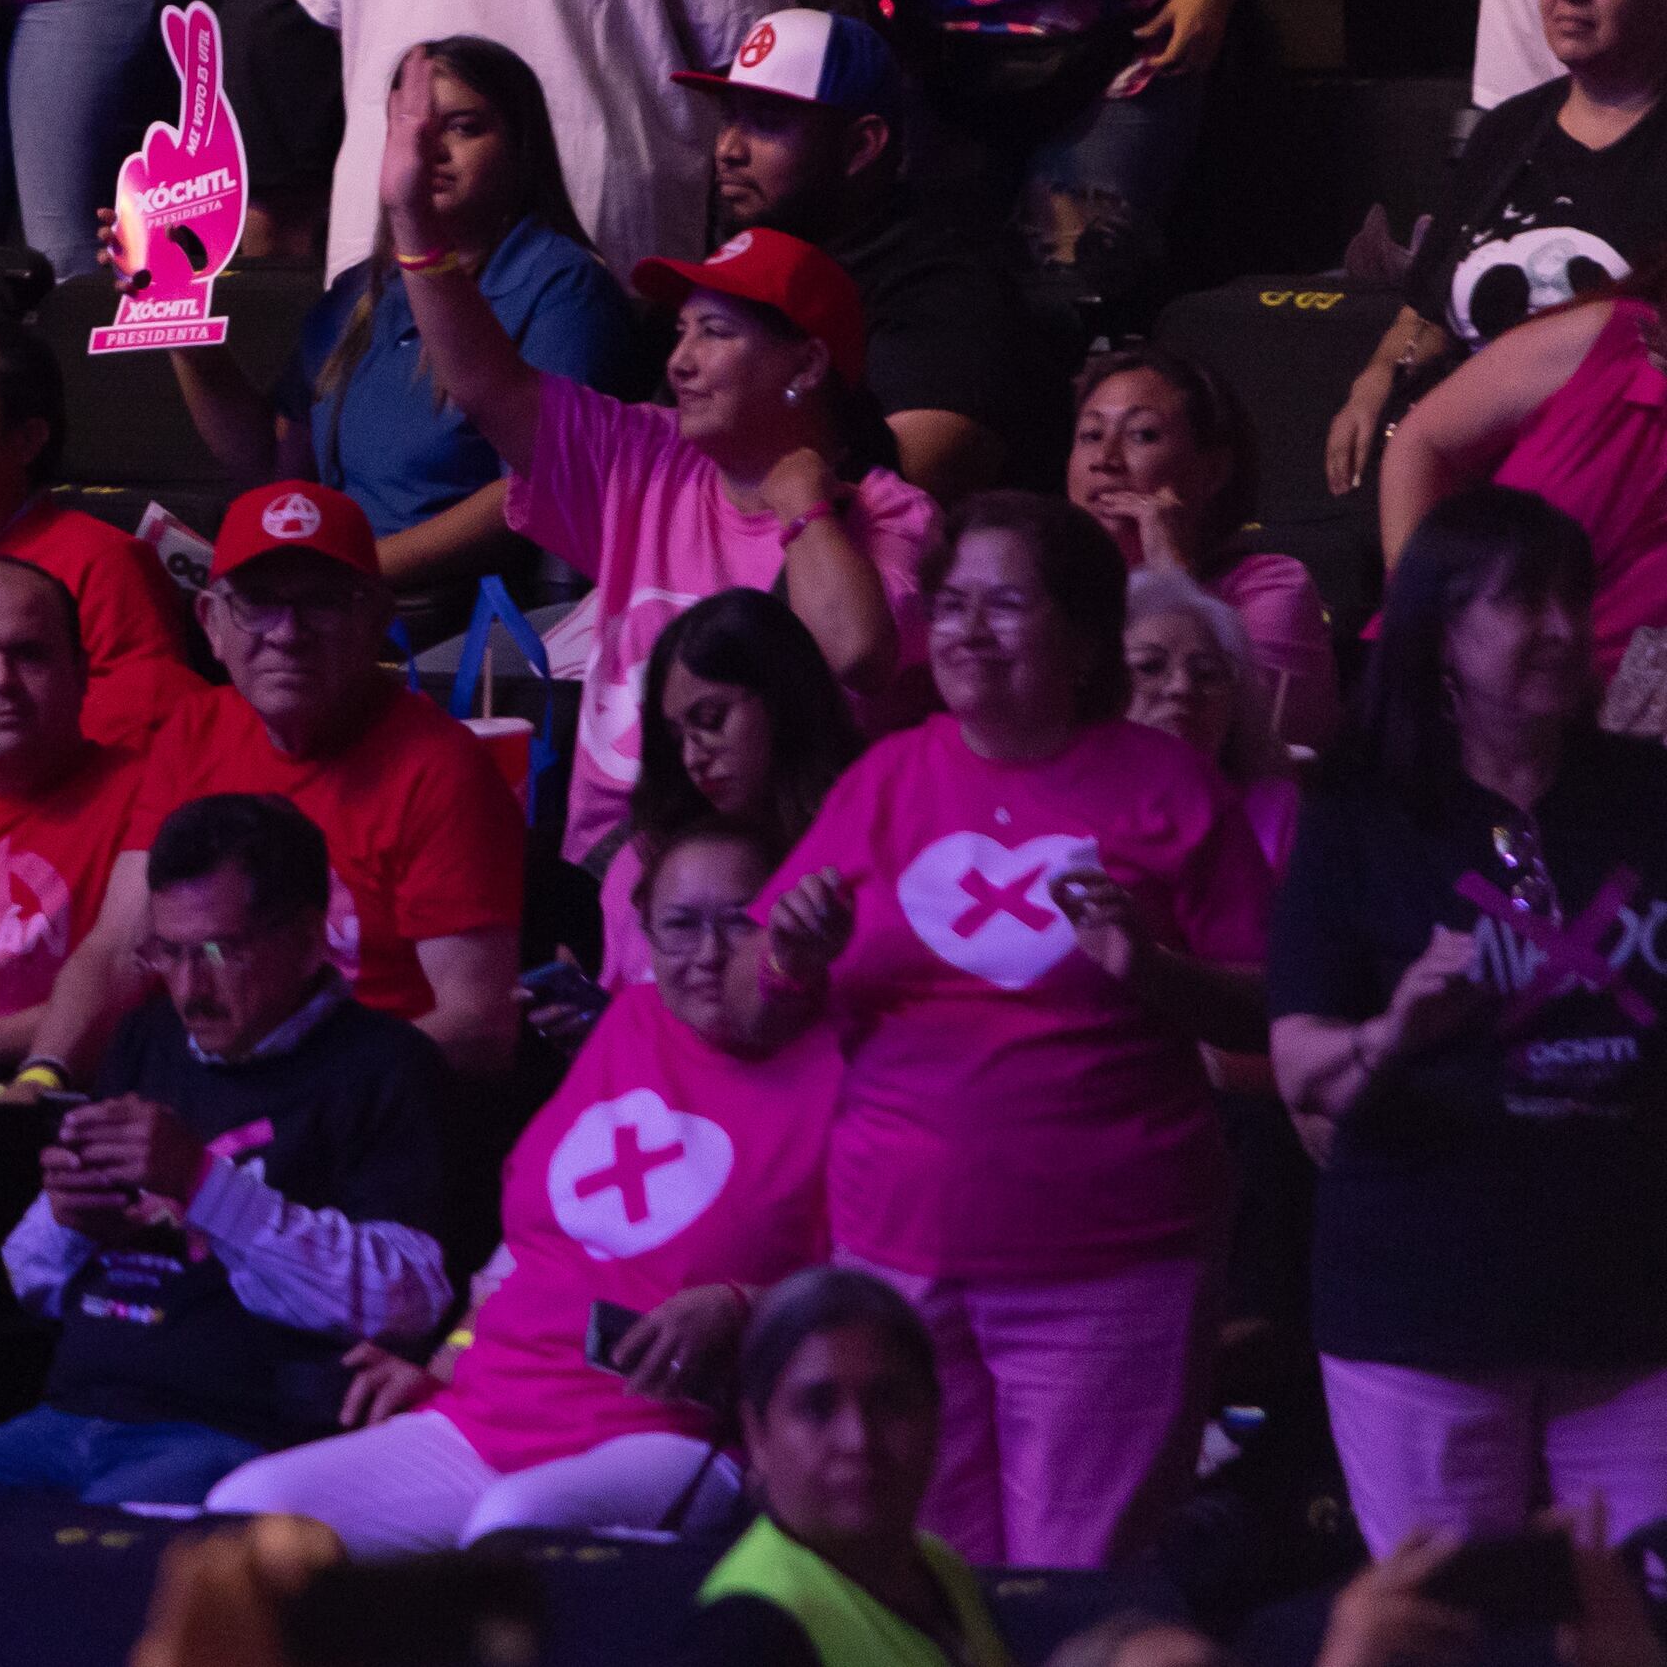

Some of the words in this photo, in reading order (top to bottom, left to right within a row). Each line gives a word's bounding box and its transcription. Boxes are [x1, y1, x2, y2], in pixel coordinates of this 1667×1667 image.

[192, 90, 208, 130] VOTO
[134, 166, 238, 216] XÓCHITL
[125, 296, 200, 323] XÓCHITL
[105, 325, 211, 348] PRESIDENTA
